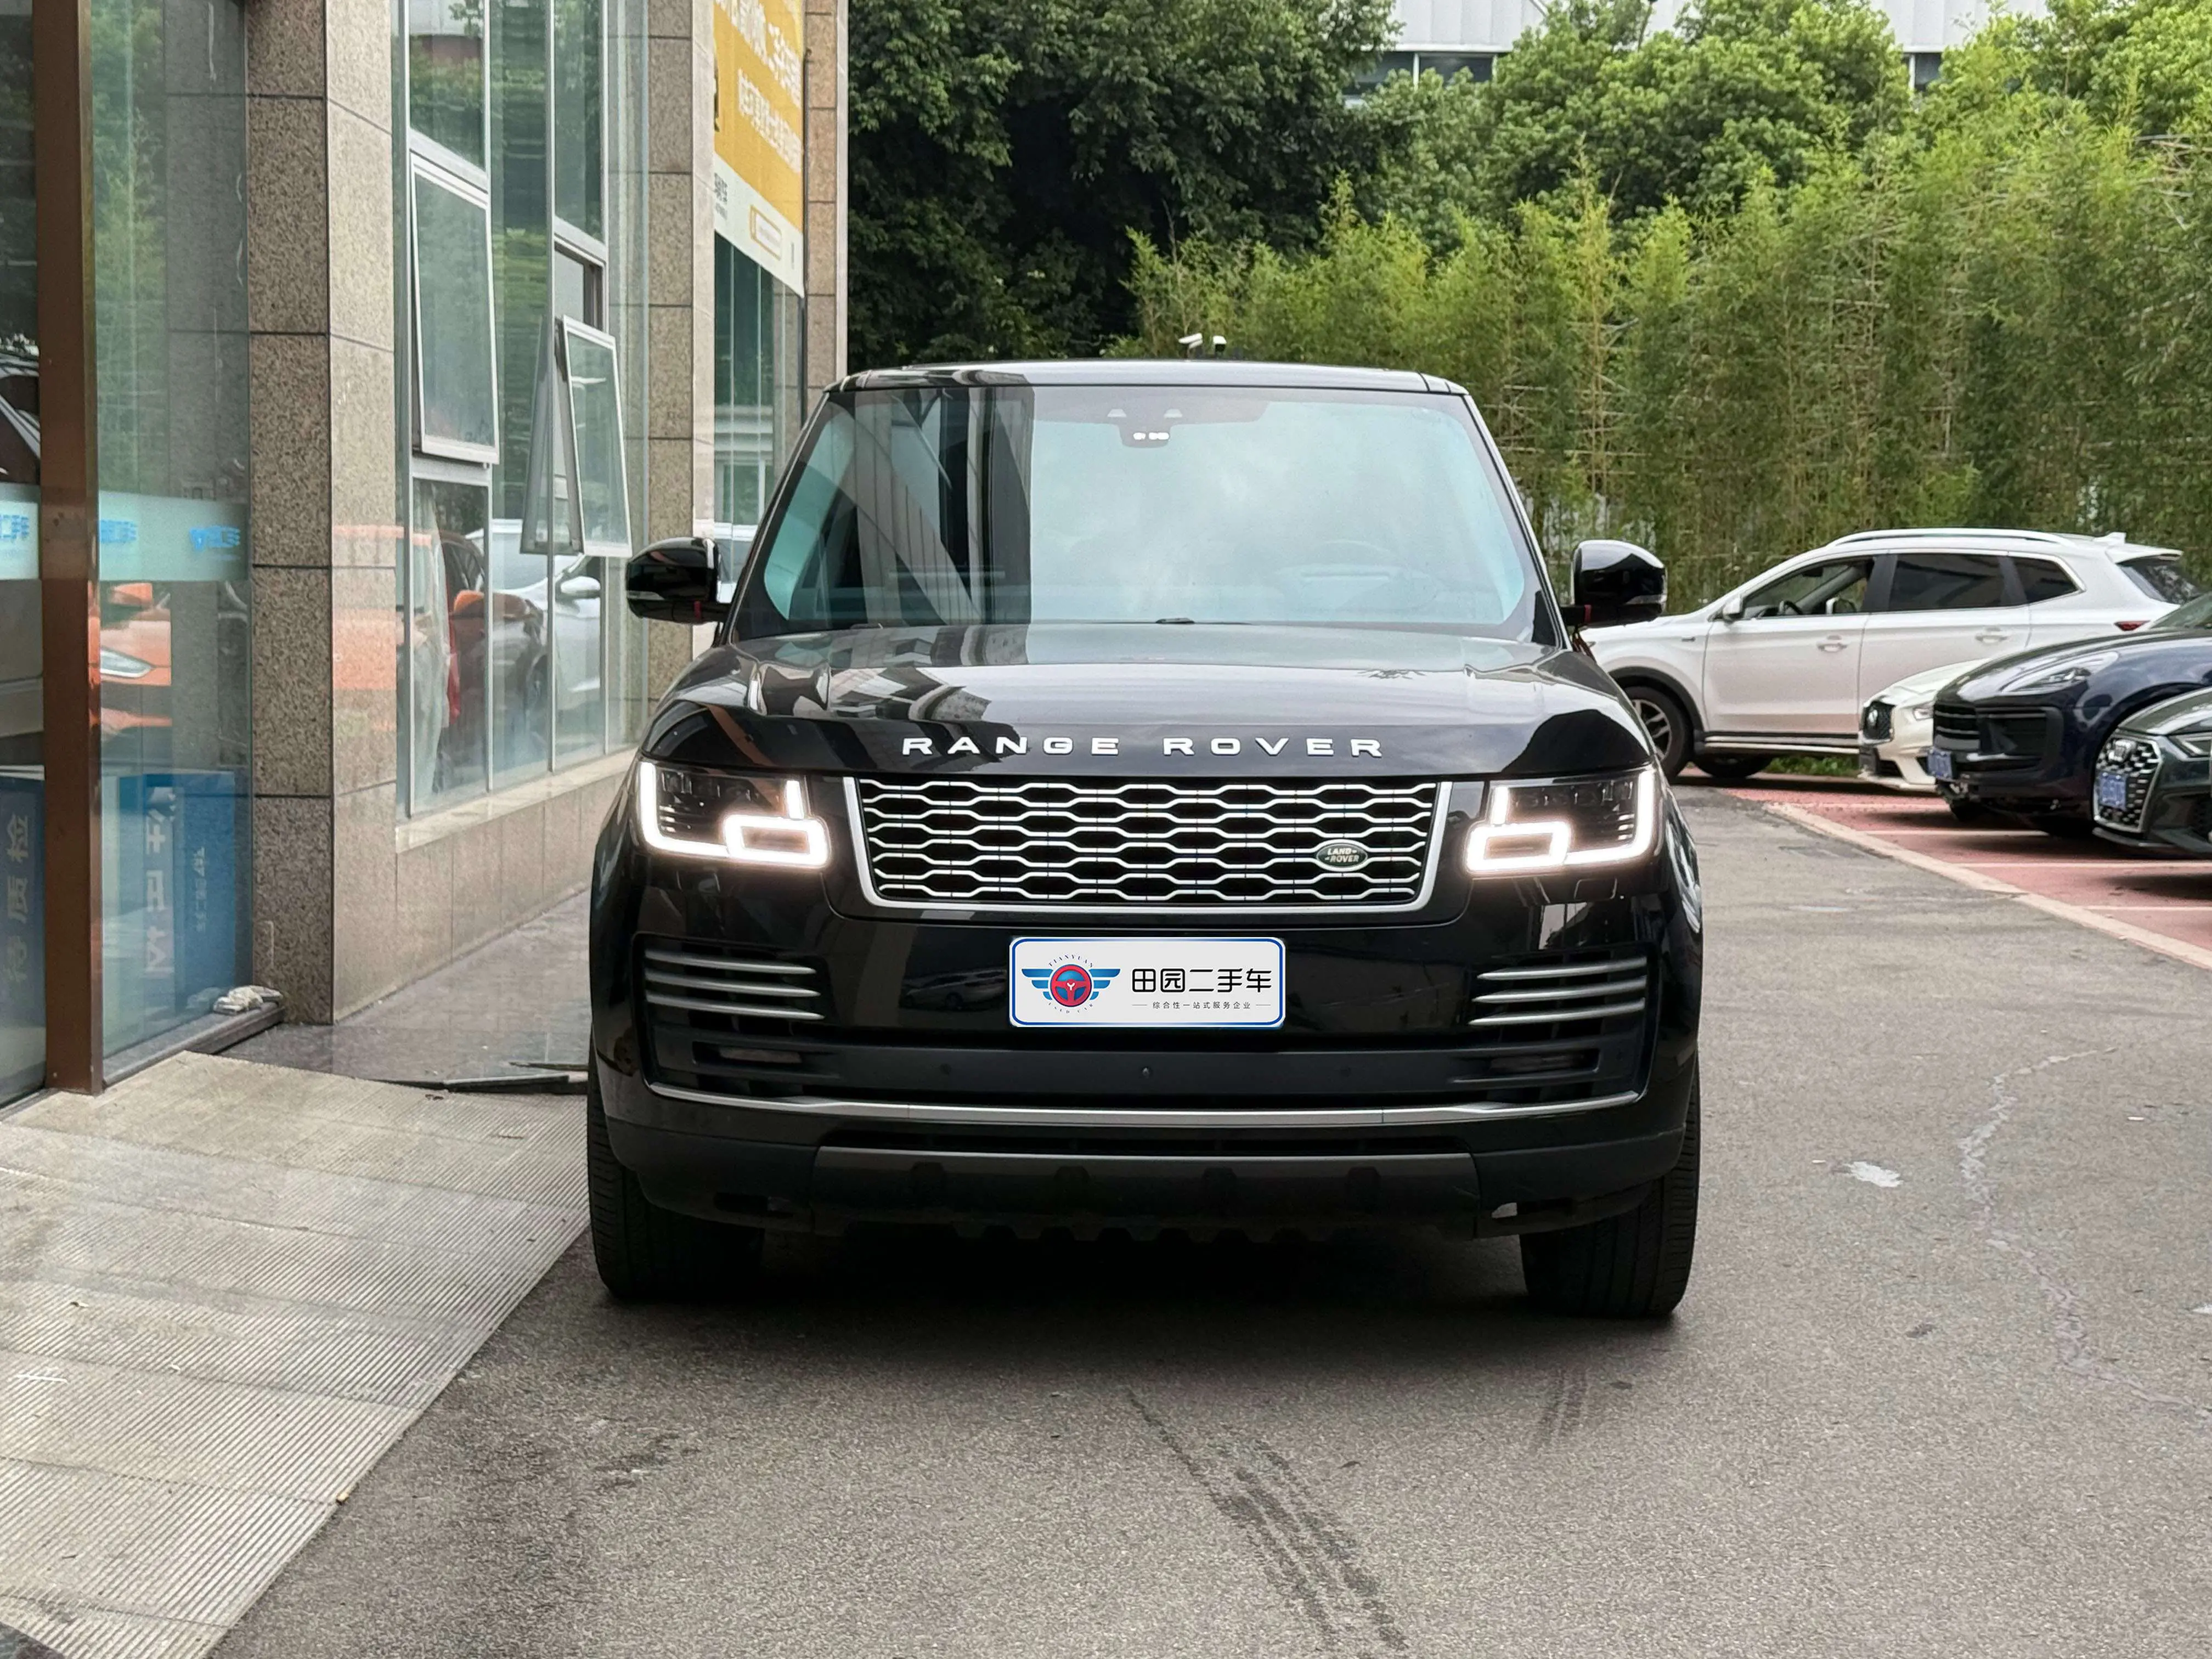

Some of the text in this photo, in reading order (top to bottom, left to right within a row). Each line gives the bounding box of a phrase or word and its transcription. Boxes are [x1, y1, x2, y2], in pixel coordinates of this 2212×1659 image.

[902, 737, 1382, 757] RANGE ROVER
[1329, 855, 1359, 863] ROVER
